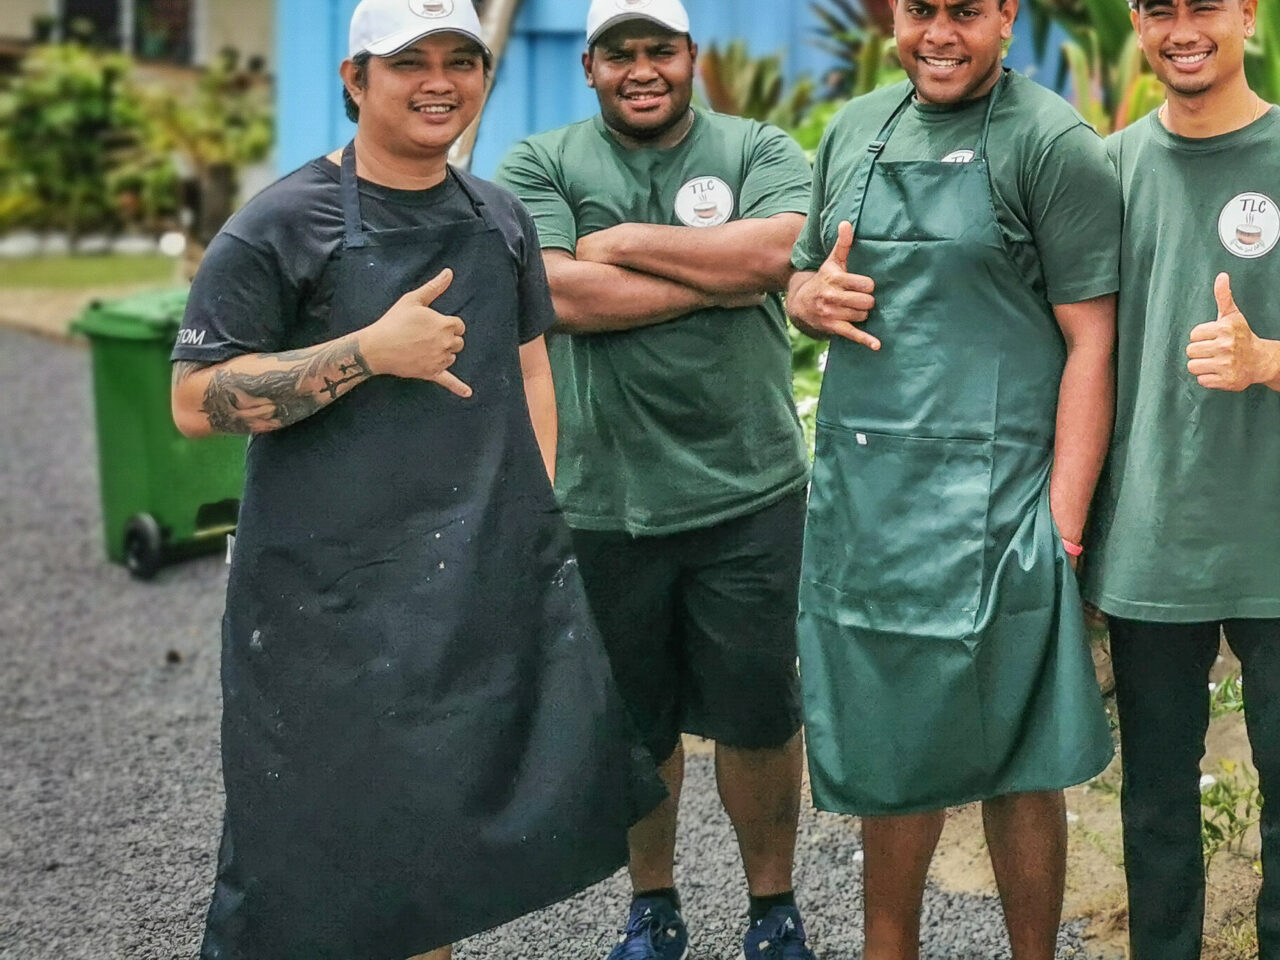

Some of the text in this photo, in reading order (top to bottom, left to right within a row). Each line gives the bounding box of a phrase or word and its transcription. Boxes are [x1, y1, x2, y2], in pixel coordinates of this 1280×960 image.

[689, 179, 715, 195] TLC
[1239, 198, 1267, 214] TLC
[177, 328, 207, 346] TOM
